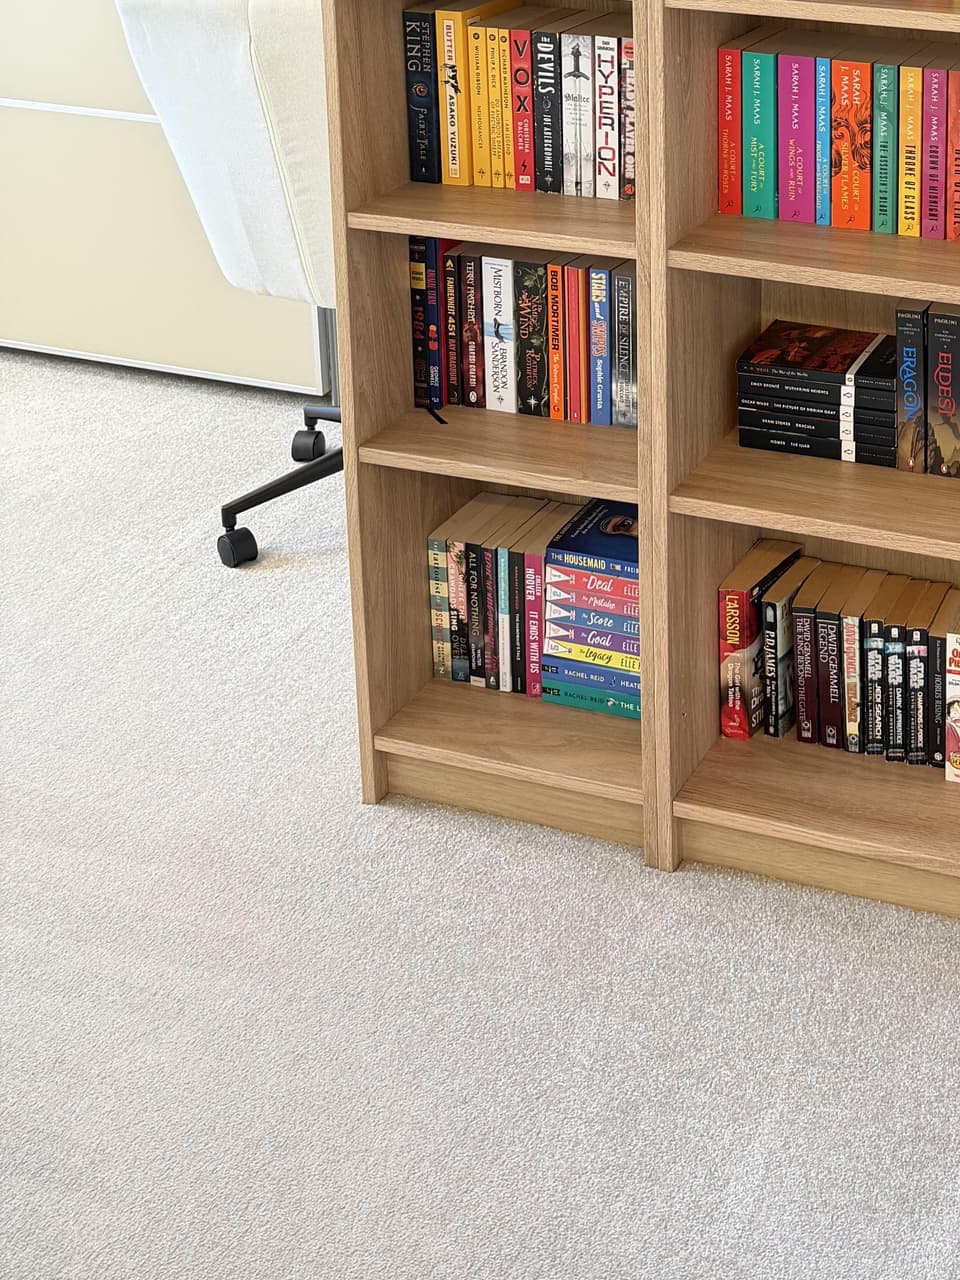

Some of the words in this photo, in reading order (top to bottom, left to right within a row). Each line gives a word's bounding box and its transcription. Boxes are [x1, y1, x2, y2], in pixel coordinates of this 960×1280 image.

[406, 21, 421, 72] KING
[514, 39, 530, 113] VOX
[537, 43, 555, 94] DEVILS
[852, 69, 860, 105] SARAH
[598, 53, 616, 177] HYPERION
[490, 267, 502, 317] MISTBORN
[550, 270, 559, 292] BOB
[592, 272, 606, 302] STARS
[551, 294, 560, 350] MORTIMER
[900, 347, 923, 420] ERAGON
[934, 352, 956, 416] ELDEST
[564, 554, 606, 570] HOUSEMAID
[525, 568, 535, 601] HOOVER
[587, 576, 613, 592] Deal
[587, 612, 614, 627] Score
[587, 631, 612, 647] Goal
[726, 595, 739, 645] LARSSON
[585, 647, 612, 664] Legacy
[818, 623, 829, 662] LEGEND
